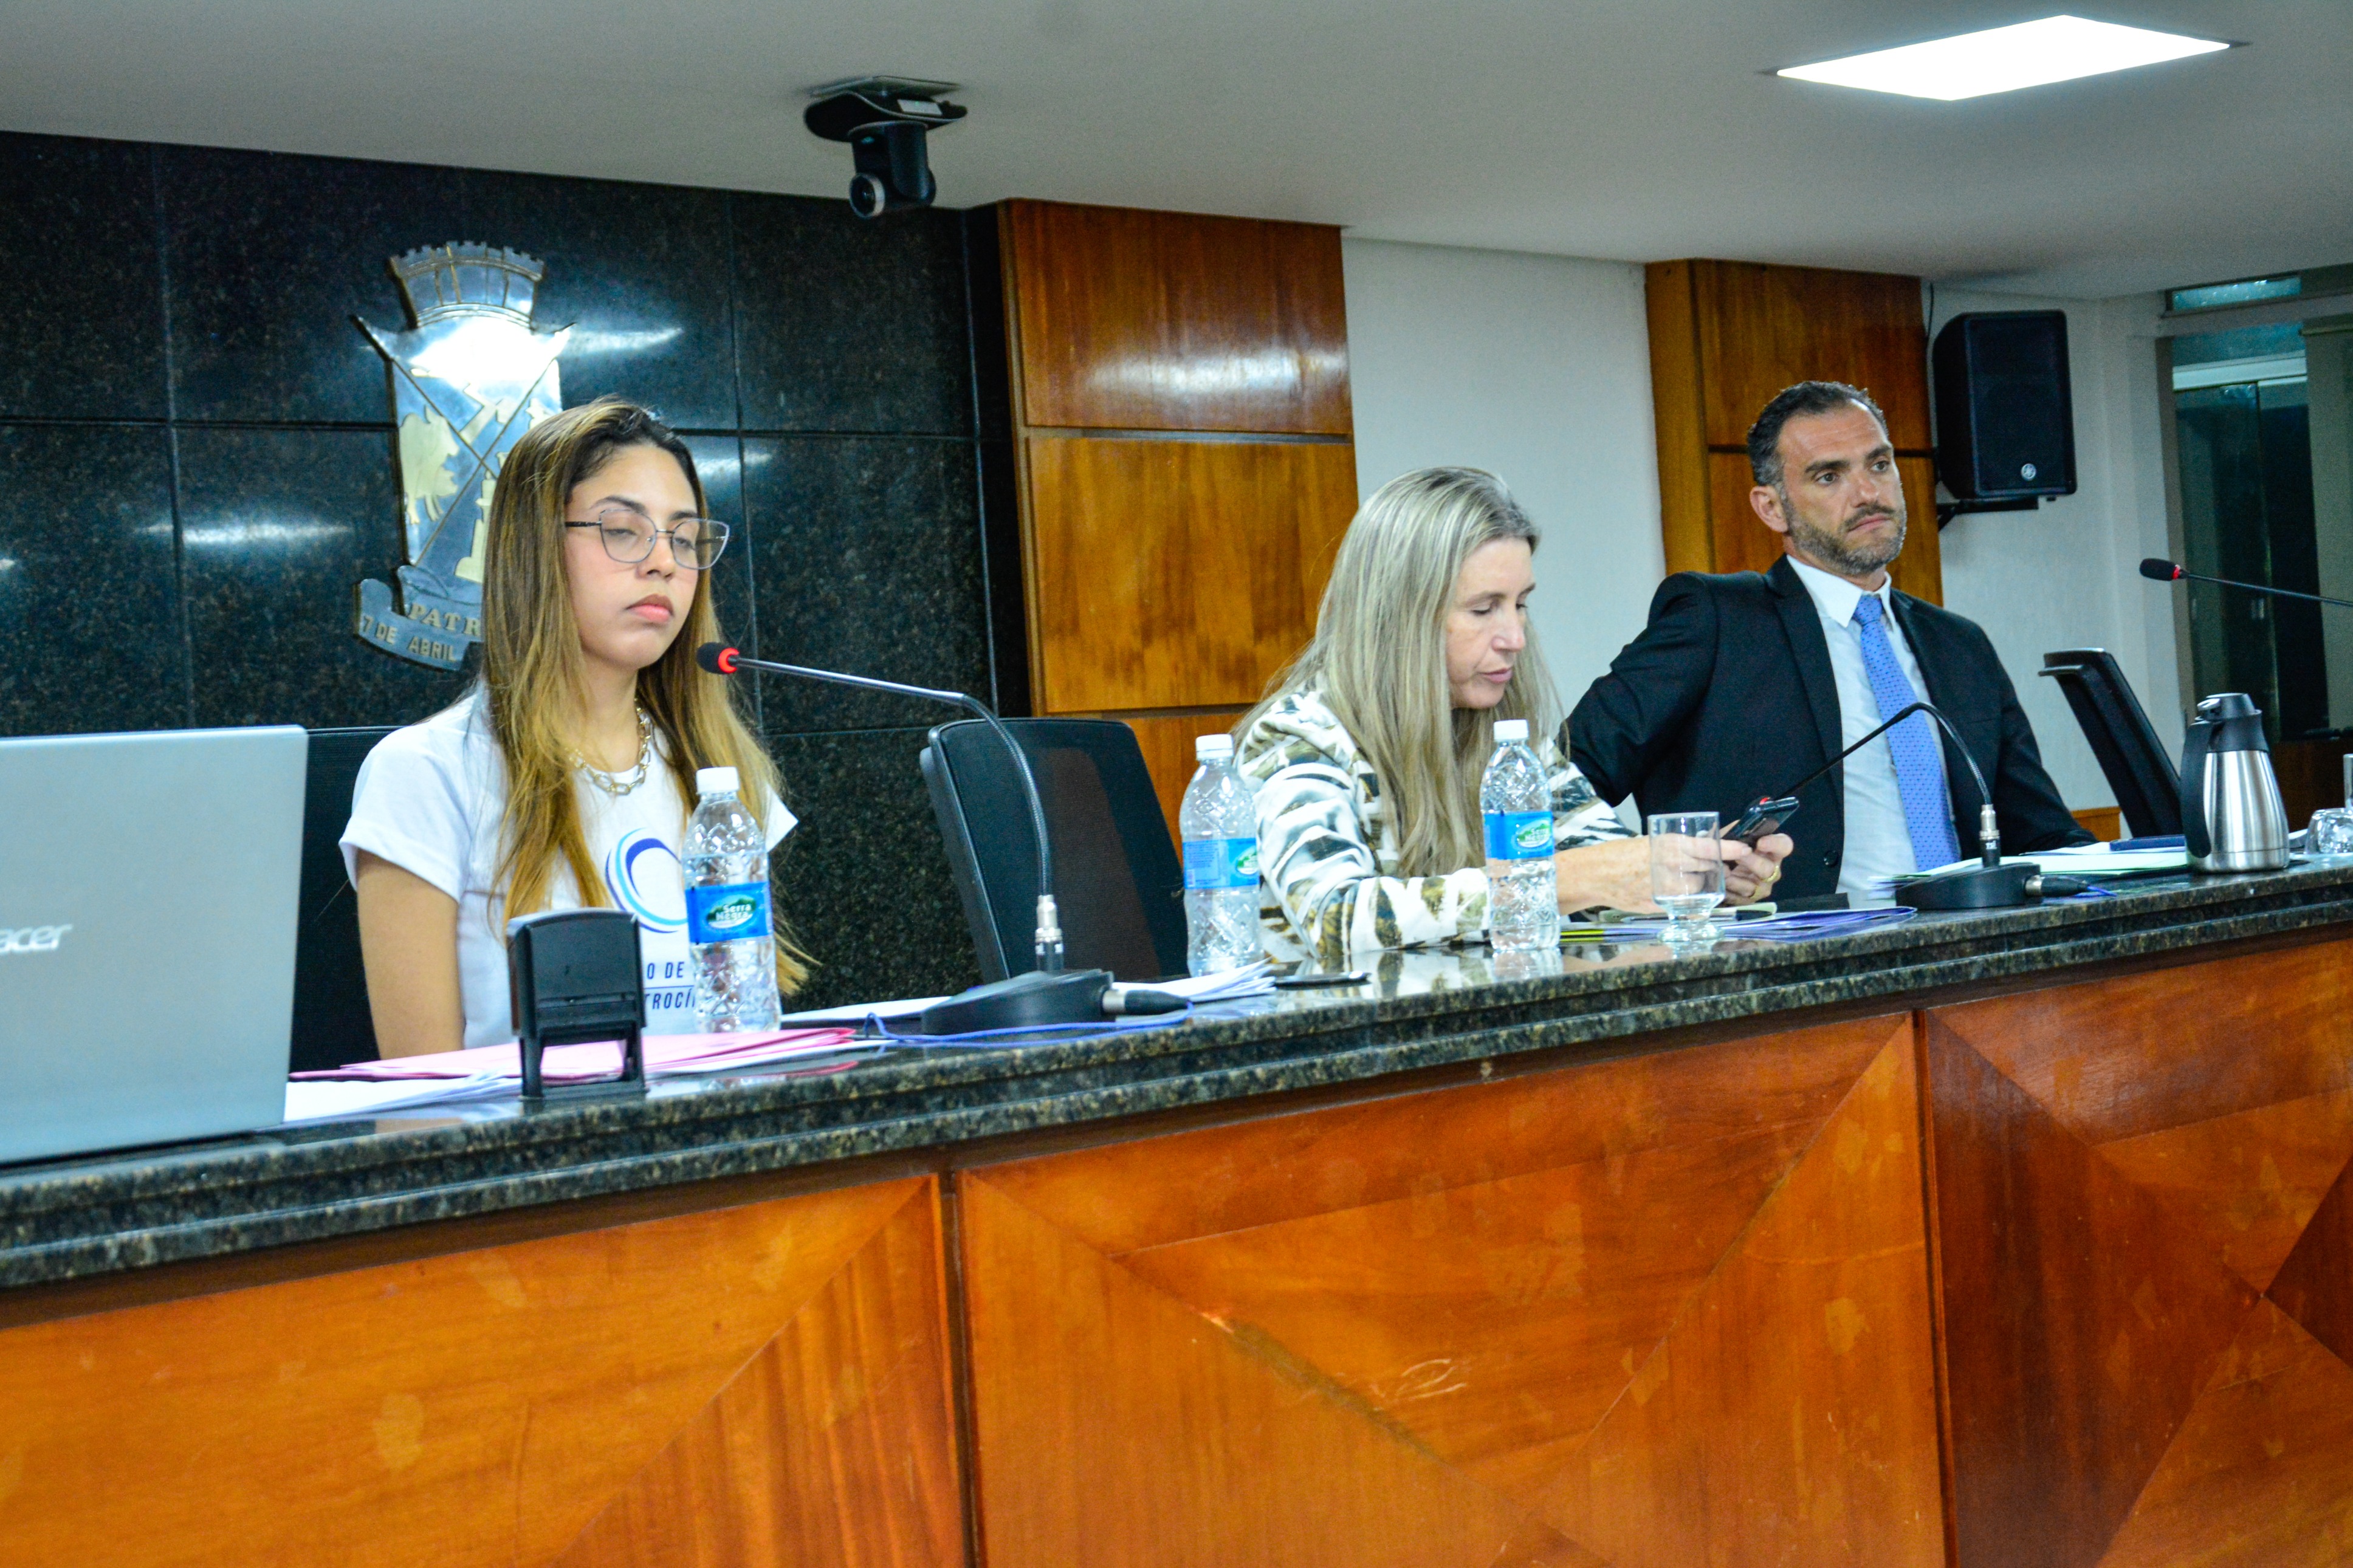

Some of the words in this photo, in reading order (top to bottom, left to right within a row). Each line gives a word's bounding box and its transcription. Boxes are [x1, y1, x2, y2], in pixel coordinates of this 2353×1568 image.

[376, 621, 397, 645] DE
[408, 636, 457, 662] ABRIL
[715, 911, 749, 921] Negra
[723, 904, 752, 914] Serra
[665, 961, 685, 979] DE
